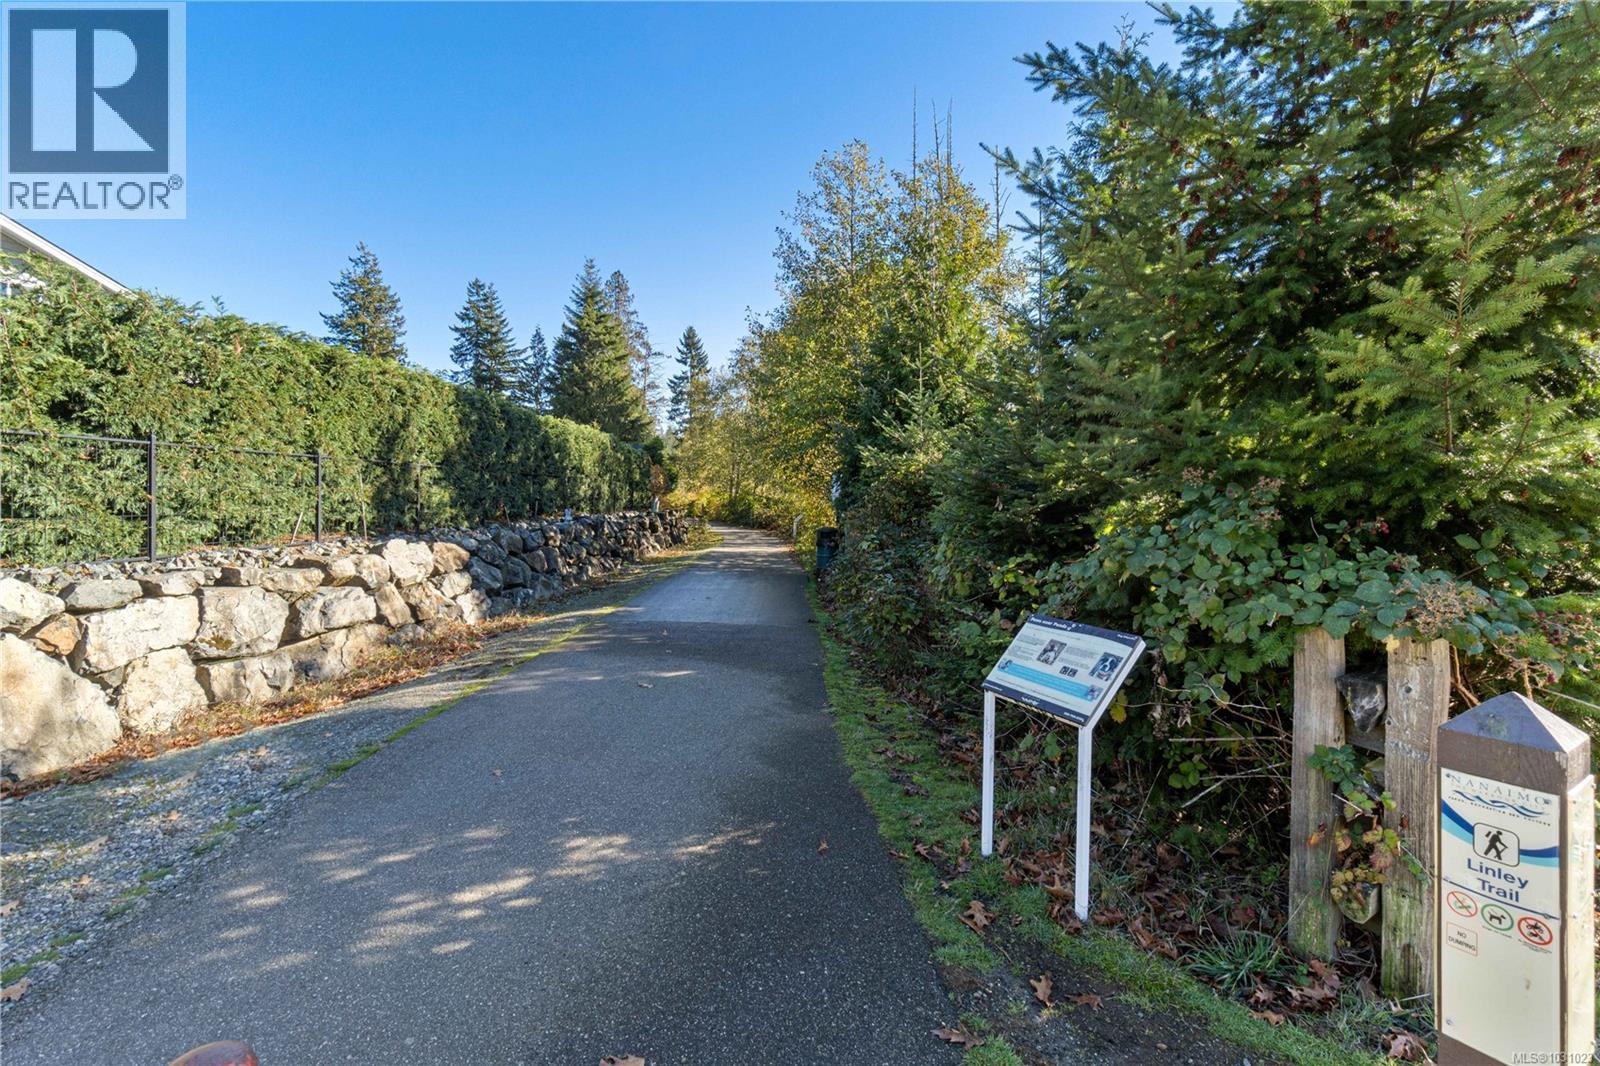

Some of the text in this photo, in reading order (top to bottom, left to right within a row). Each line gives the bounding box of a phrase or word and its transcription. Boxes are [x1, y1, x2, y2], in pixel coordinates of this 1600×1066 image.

[1450, 774, 1548, 806] NANAIMO
[1467, 858, 1529, 889] Linley
[1477, 878, 1520, 903] Trail
[1448, 935, 1476, 951] DUMPING
[1457, 930, 1467, 939] NO
